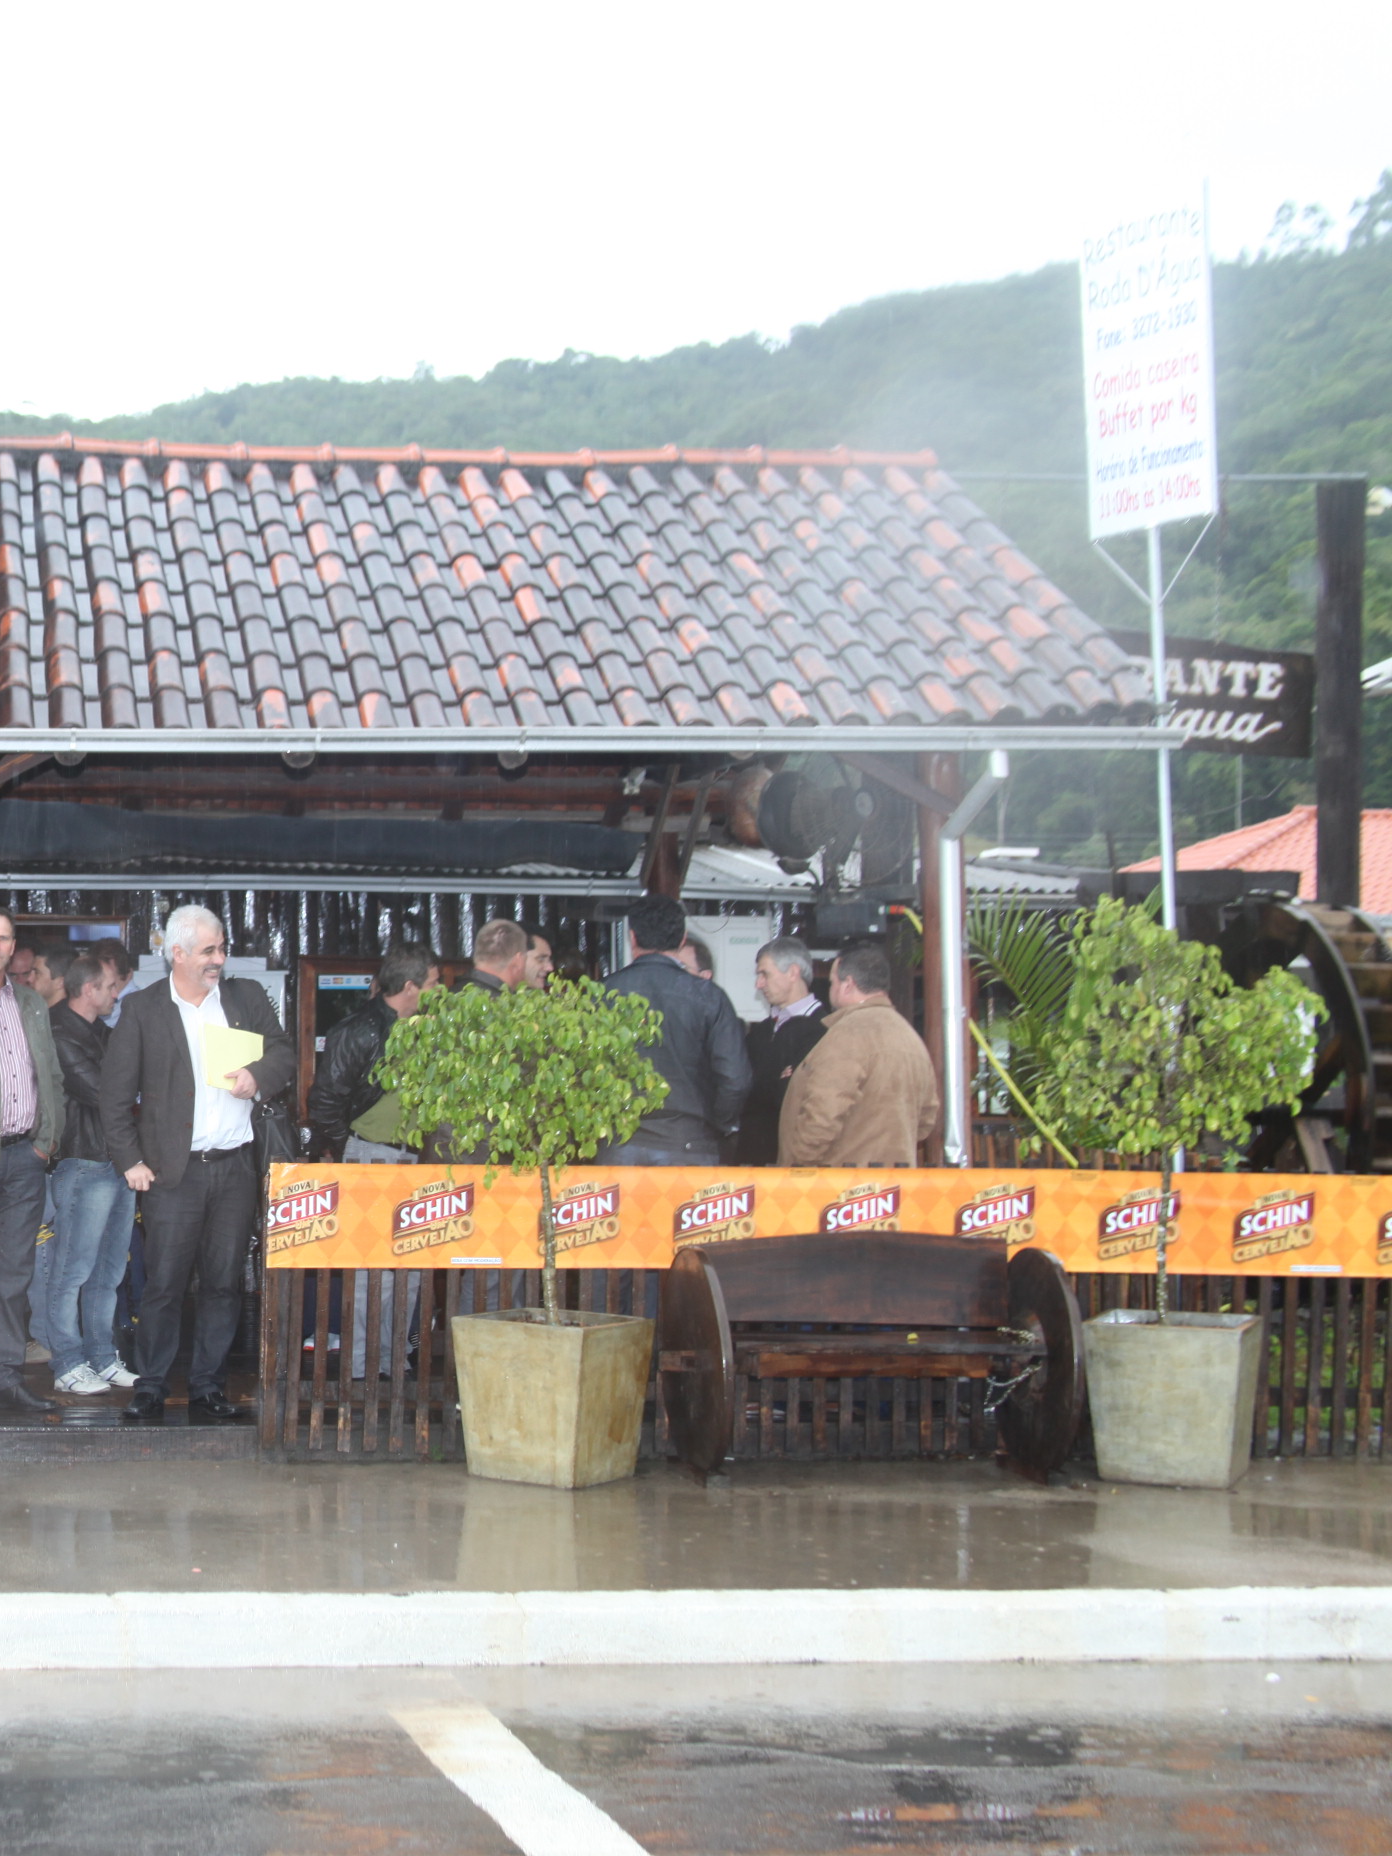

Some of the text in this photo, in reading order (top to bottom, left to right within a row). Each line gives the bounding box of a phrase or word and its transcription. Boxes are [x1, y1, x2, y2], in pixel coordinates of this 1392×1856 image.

[1084, 203, 1201, 271] Restaurante
[1089, 270, 1131, 311] Roda
[1093, 350, 1199, 400] Comida caseira
[1099, 376, 1198, 439] Buffet por kg
[1129, 447, 1138, 474] de
[287, 1181, 311, 1194] NOVA
[422, 1181, 446, 1194] NOVA
[568, 1183, 592, 1195] NOVA
[703, 1183, 727, 1196] NOVA
[267, 1190, 332, 1228] SCHIN
[400, 1191, 467, 1228] SCHIN
[680, 1193, 748, 1229] SCHIN
[826, 1193, 894, 1230] SCHIN
[961, 1194, 1029, 1231] SCHIN
[1240, 1200, 1310, 1236] SCHIN
